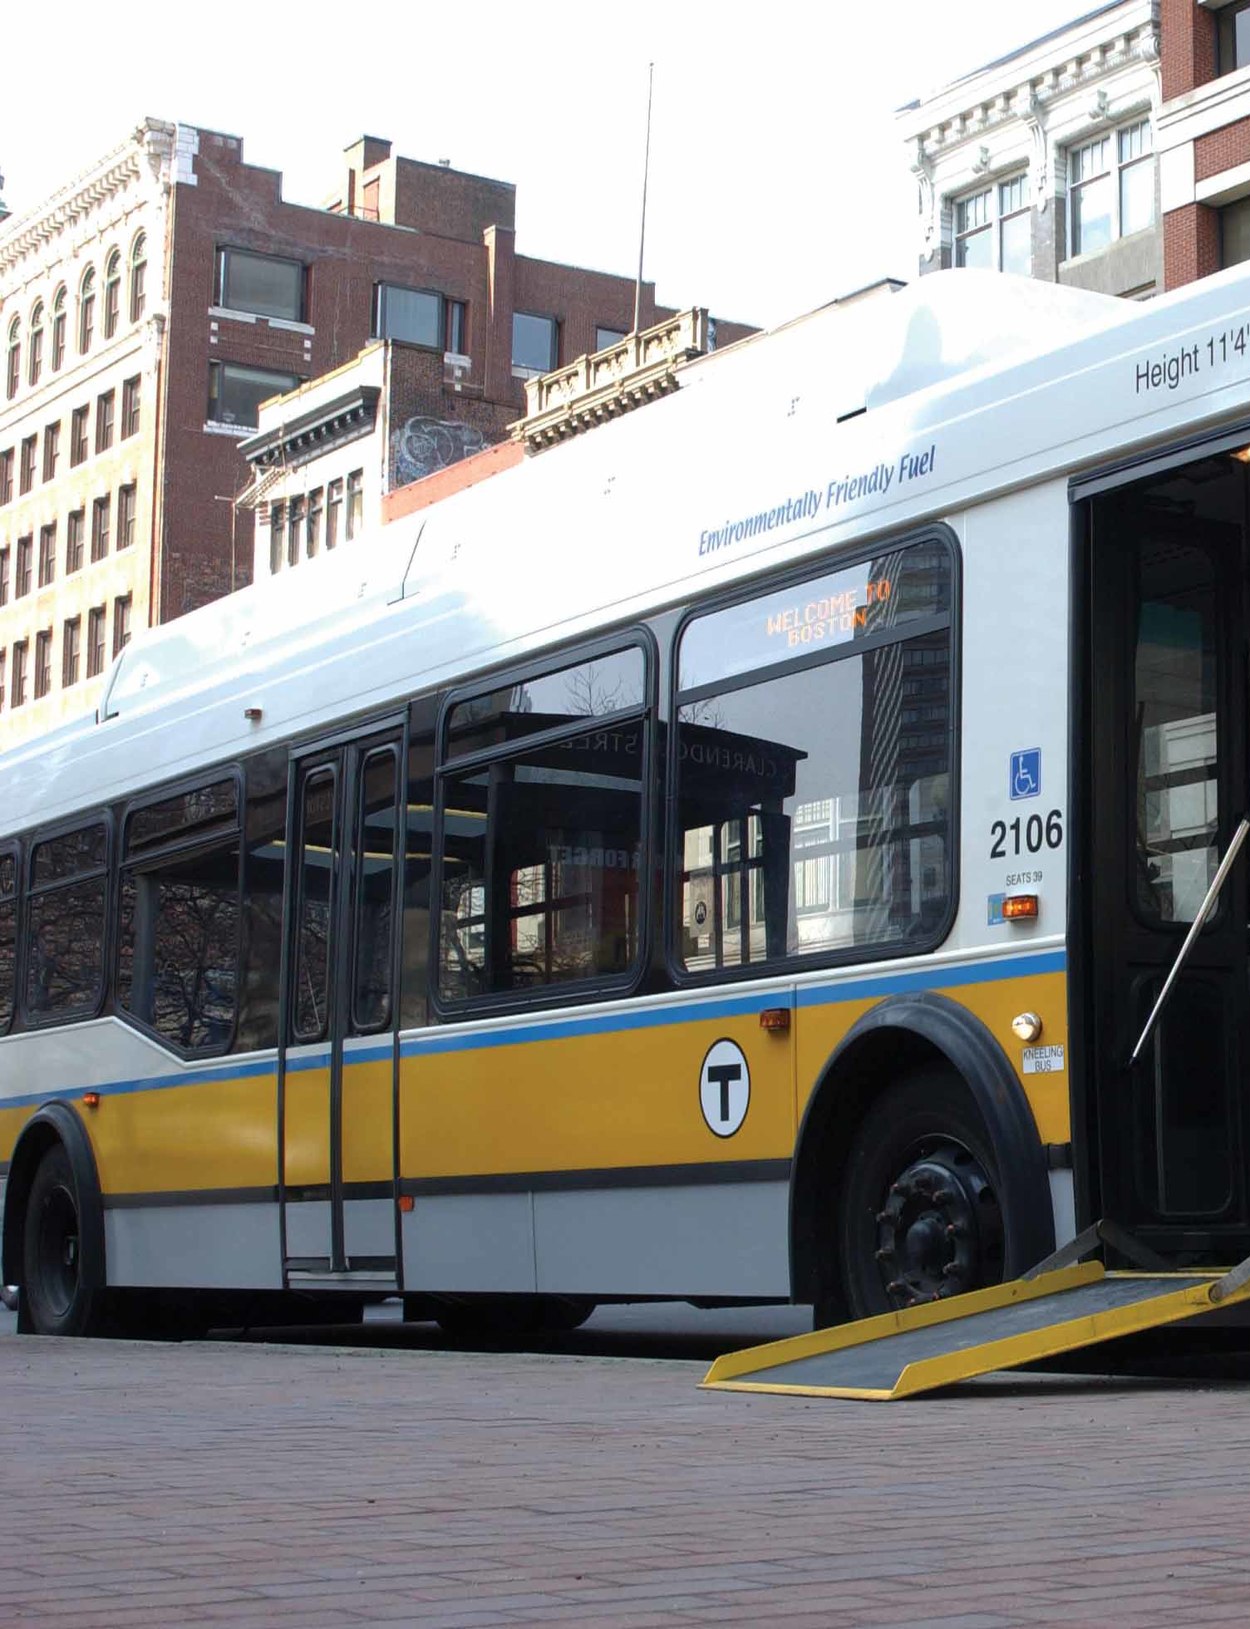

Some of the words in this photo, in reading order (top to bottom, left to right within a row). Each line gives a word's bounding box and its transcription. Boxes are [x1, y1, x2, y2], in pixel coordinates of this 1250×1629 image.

[1135, 343, 1200, 394] Height
[698, 488, 823, 556] Environmentally
[826, 459, 895, 509] Friendly
[898, 445, 936, 483] Fuel
[766, 590, 858, 636] WELCOME
[866, 579, 891, 605] TO
[786, 607, 867, 648] BOSTON
[990, 809, 1063, 859] 2106
[1006, 872, 1032, 886] SEATS
[1033, 871, 1043, 882] 39
[1023, 1046, 1064, 1061] KNEELING
[1035, 1059, 1051, 1072] BUS
[707, 1063, 742, 1122] T
